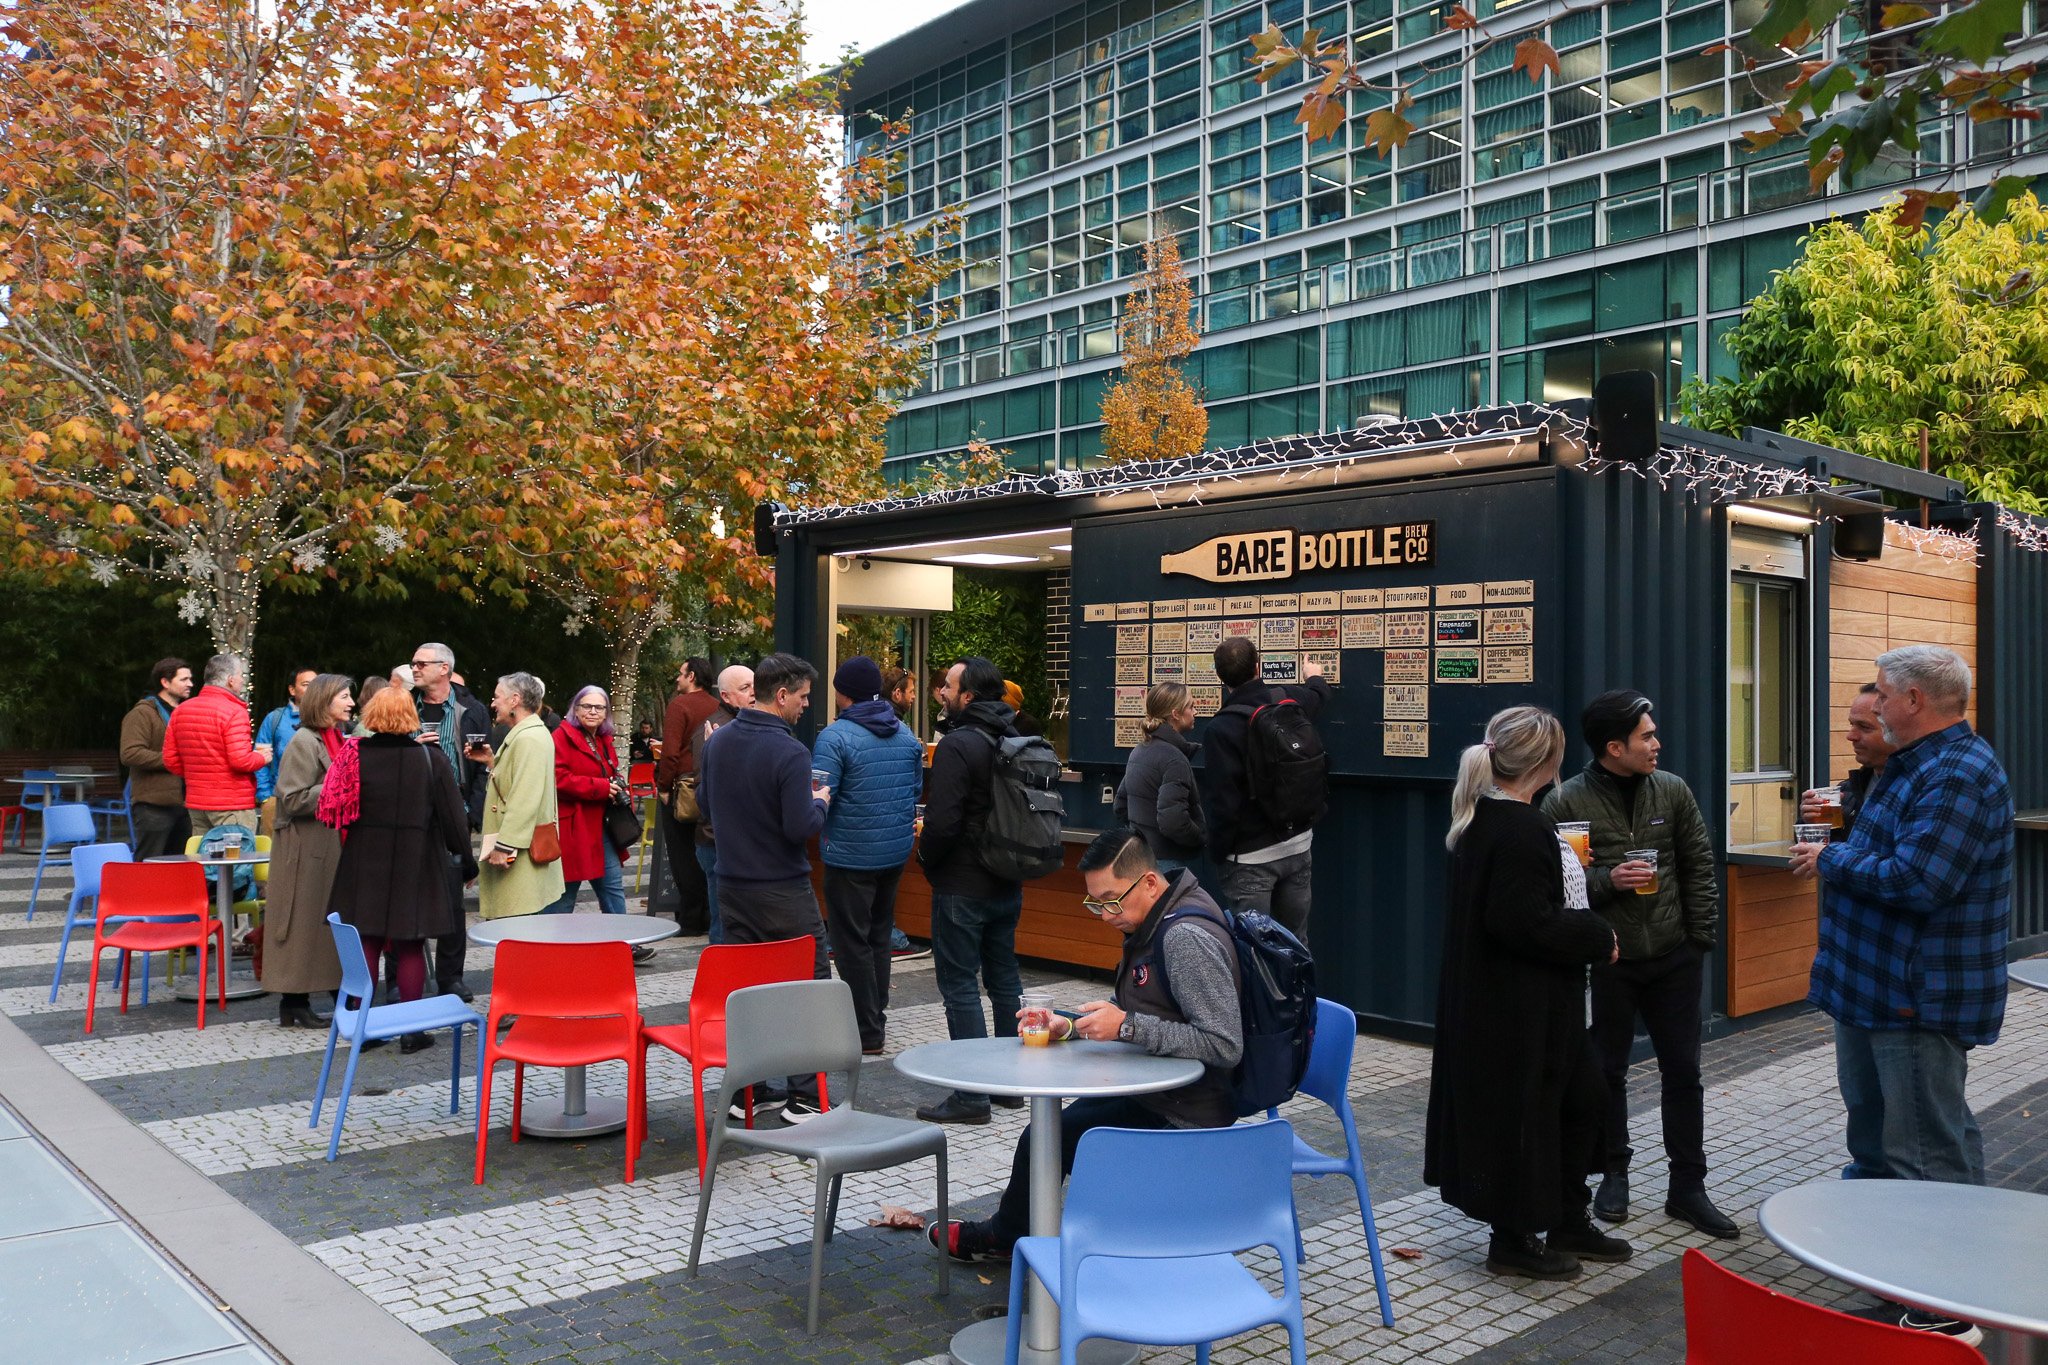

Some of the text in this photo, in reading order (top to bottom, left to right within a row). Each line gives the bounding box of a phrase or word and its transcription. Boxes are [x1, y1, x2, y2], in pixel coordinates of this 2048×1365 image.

[1405, 524, 1428, 538] BREW
[1216, 526, 1402, 577] BARE BOTTLE
[1450, 590, 1467, 599] FOOD
[1486, 586, 1531, 597] NON-ALCOHOLIC
[1274, 599, 1288, 607] COAST
[1288, 598, 1297, 606] IPA
[1307, 597, 1332, 606] HAZY IPA
[1346, 594, 1378, 604] DOUBLE IPA
[1154, 604, 1185, 613] CRISPY LAGER
[1194, 602, 1216, 611] SOUR ALE
[1231, 601, 1252, 610] PALE ALE
[1095, 608, 1104, 616] INFO
[1118, 607, 1138, 615] BAREBOTTLE
[1492, 609, 1524, 618] KOGA KOLA
[1389, 613, 1424, 622] SAINT NITRO
[1189, 622, 1220, 630] ACAI-U-LATER
[1386, 651, 1427, 660] GRANDMA COCOA
[1487, 648, 1529, 657] COFFEE PRICES
[1388, 687, 1405, 695] GREAT
[1386, 724, 1401, 732] GREAT
